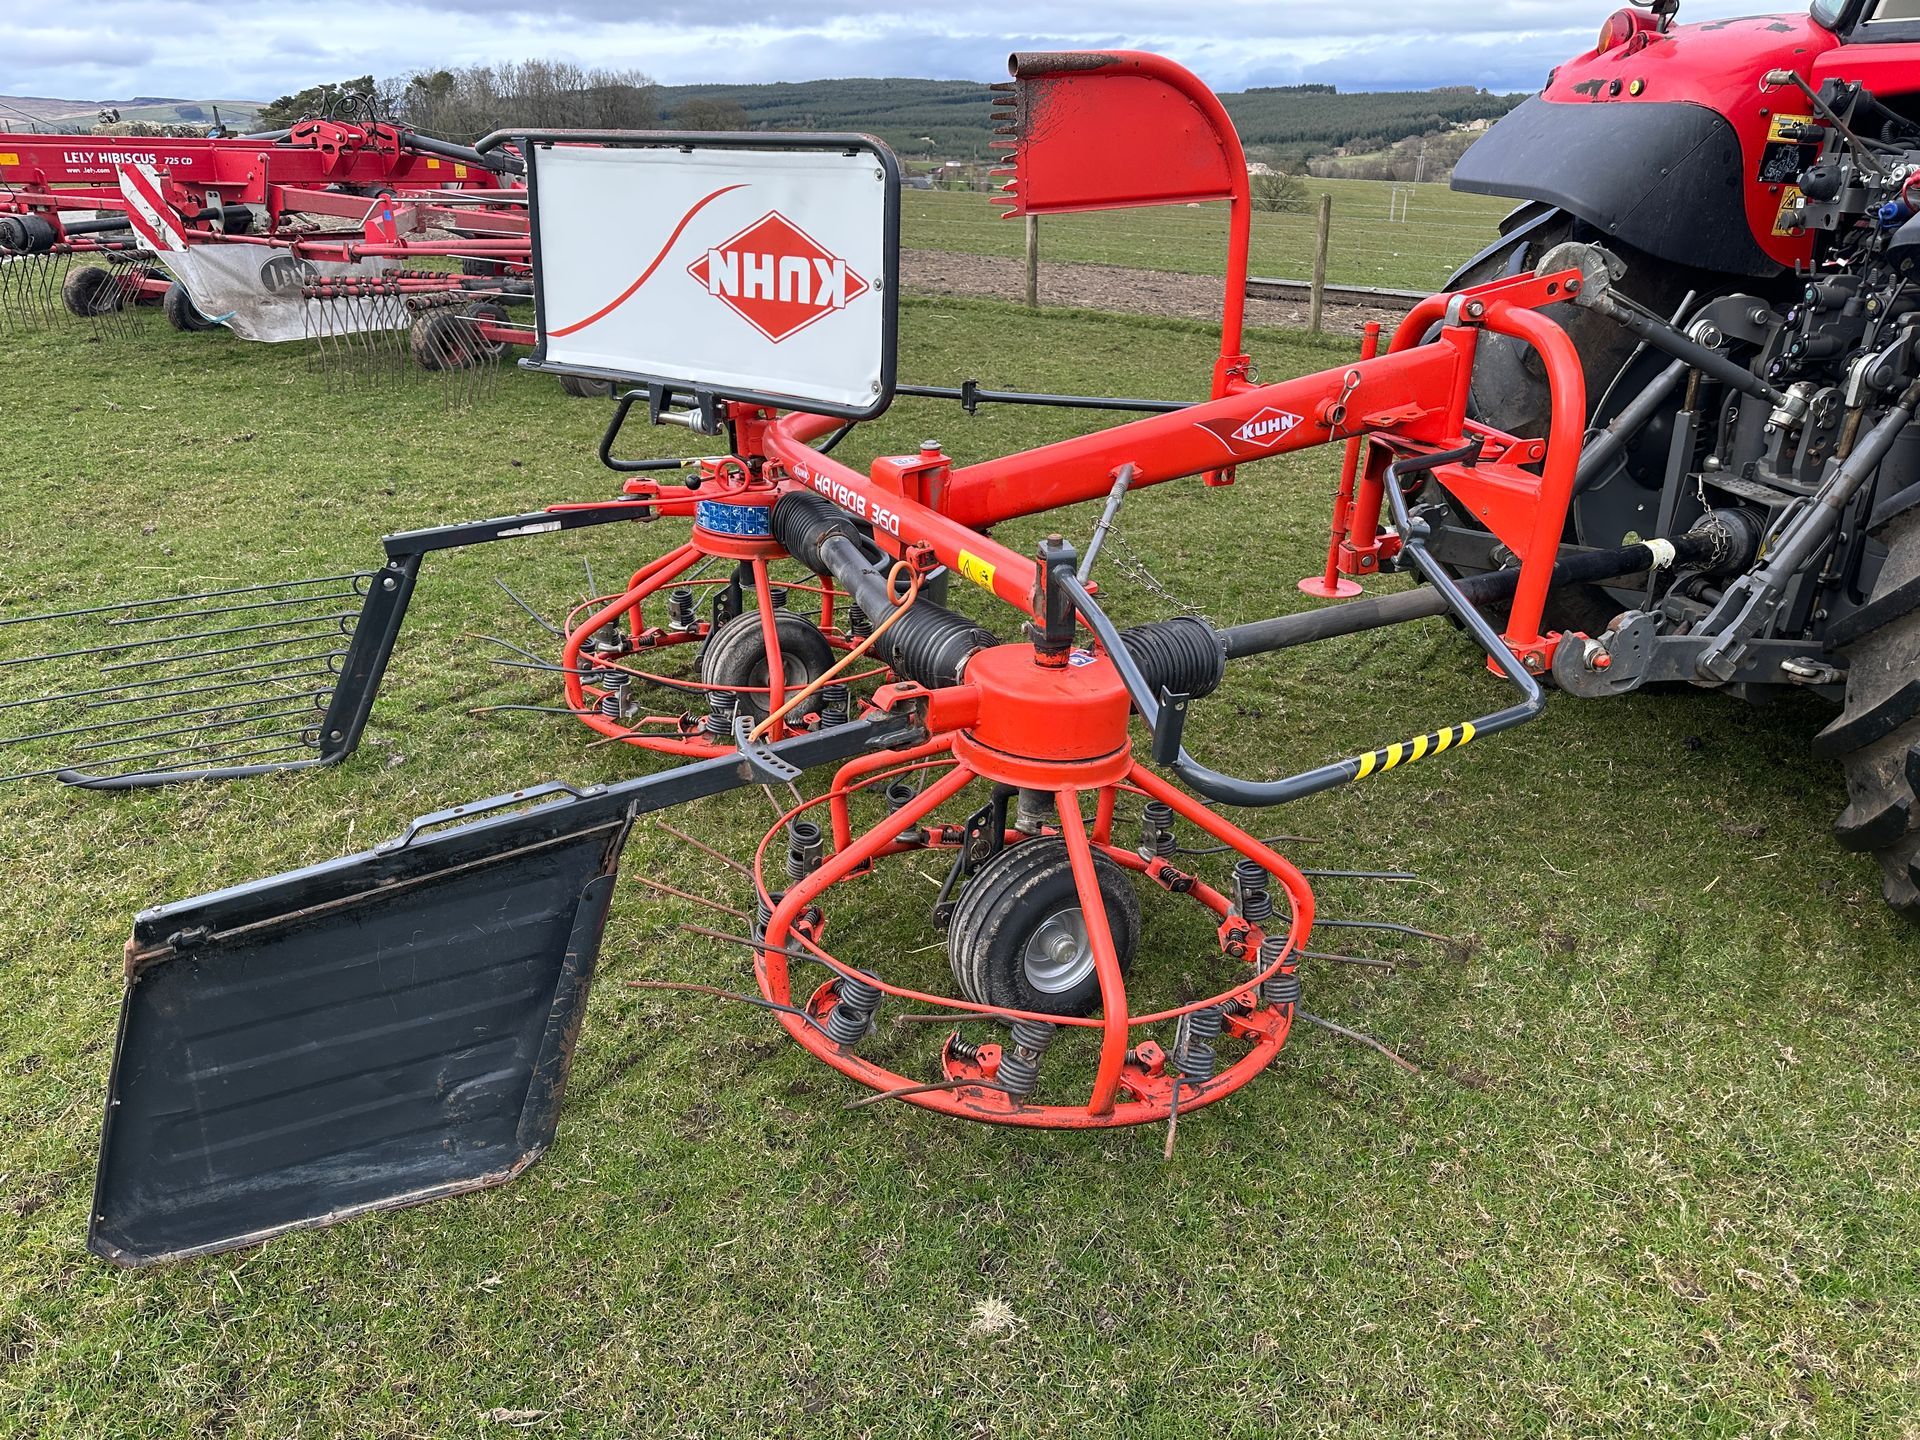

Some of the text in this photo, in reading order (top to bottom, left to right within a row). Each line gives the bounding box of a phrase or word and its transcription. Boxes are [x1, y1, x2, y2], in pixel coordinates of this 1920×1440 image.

[63, 151, 193, 165] LELY HIBISCUS 725 CD
[708, 248, 847, 309] KUHN
[1242, 414, 1295, 440] KUHN
[814, 472, 900, 537] HAYBOB 360
